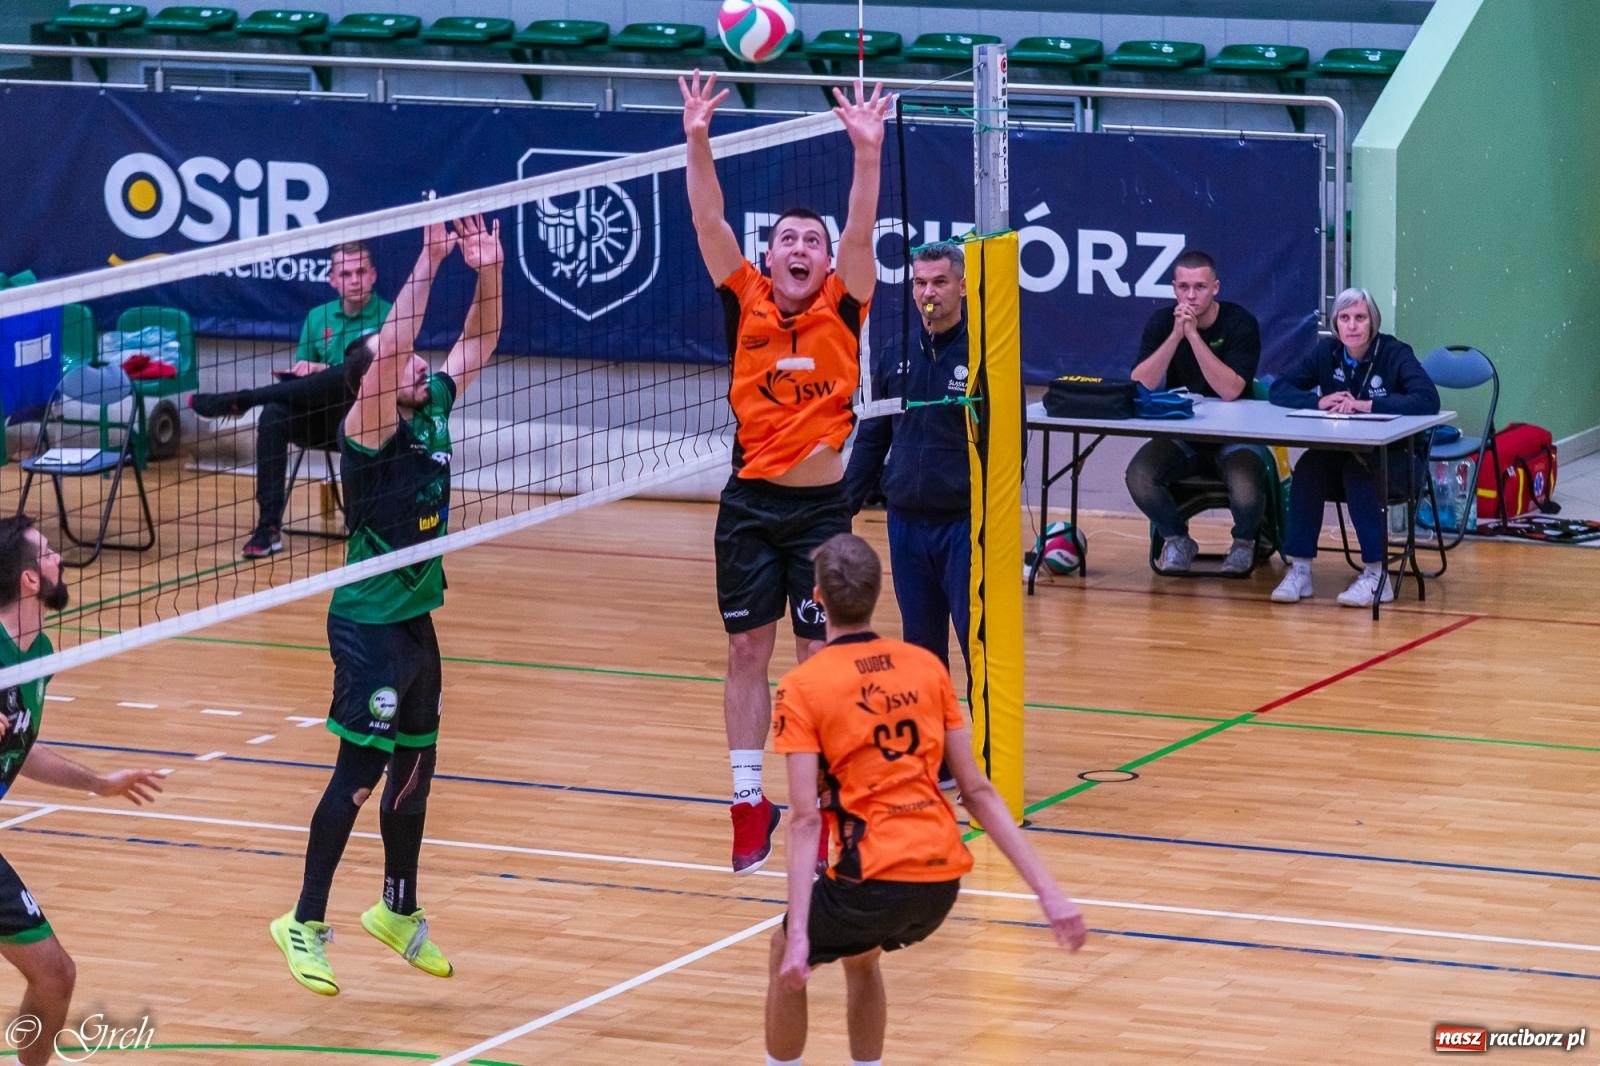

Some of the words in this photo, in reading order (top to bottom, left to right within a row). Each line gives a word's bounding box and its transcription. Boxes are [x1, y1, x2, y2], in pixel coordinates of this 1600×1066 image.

[813, 611, 827, 625] JS
[854, 653, 895, 674] DUDEK
[885, 689, 919, 713] JSW
